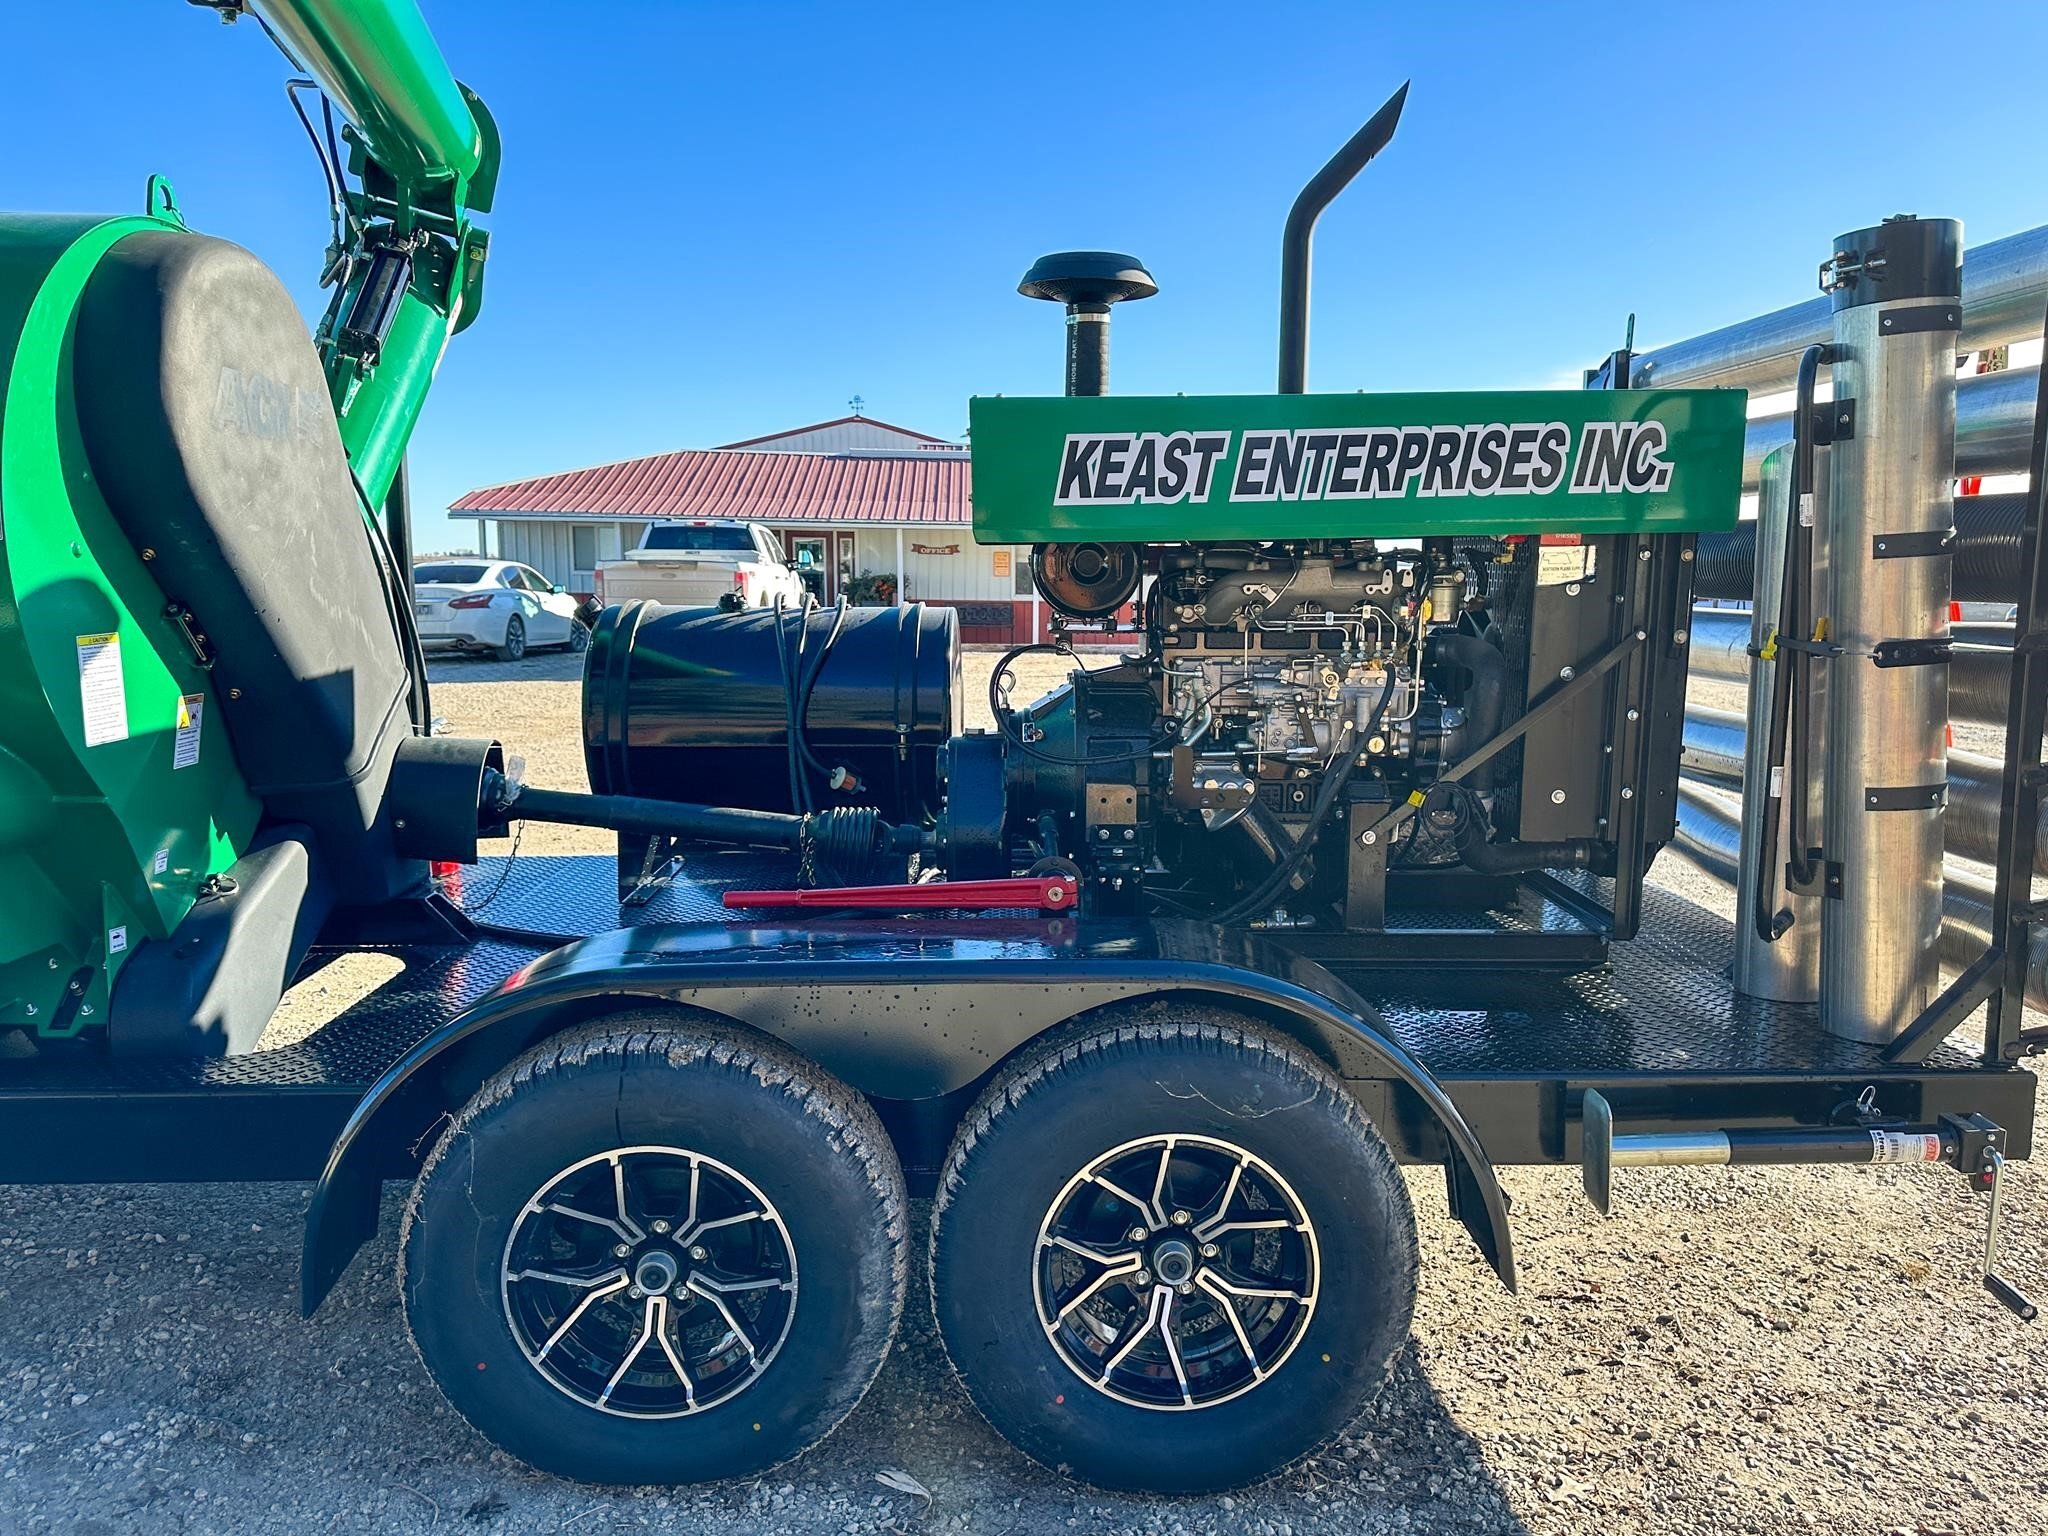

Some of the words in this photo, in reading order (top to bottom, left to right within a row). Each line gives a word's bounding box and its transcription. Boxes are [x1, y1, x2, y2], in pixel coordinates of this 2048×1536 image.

[1056, 434, 1229, 502] KEAST
[1232, 426, 1568, 498] ENTERPRISES
[1571, 424, 1672, 491] INC.
